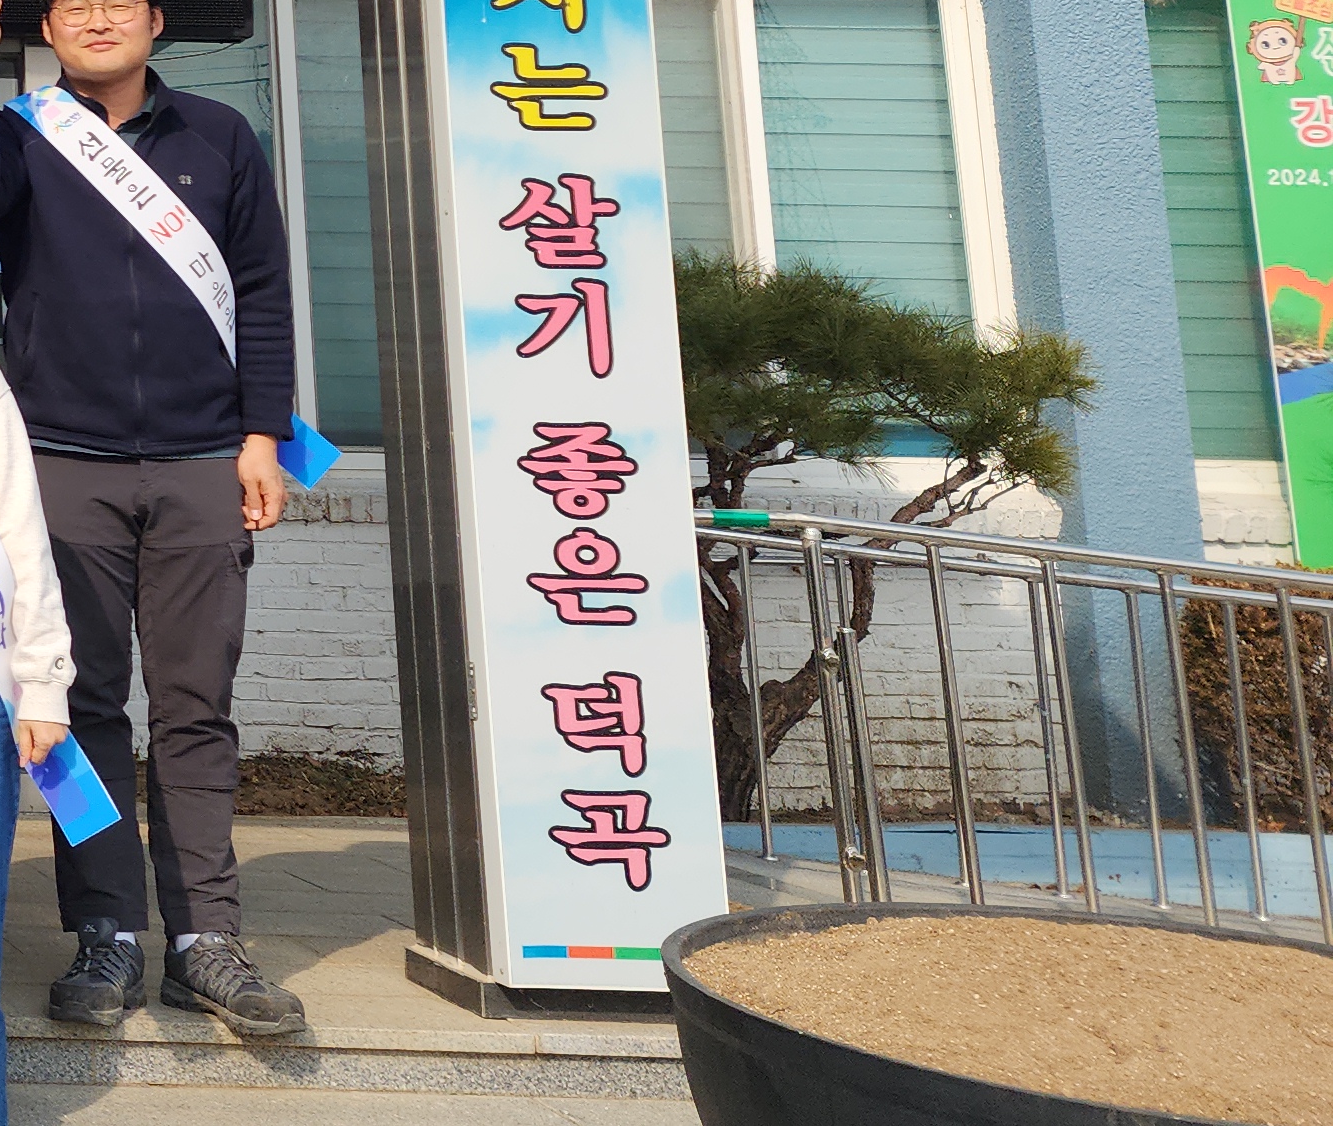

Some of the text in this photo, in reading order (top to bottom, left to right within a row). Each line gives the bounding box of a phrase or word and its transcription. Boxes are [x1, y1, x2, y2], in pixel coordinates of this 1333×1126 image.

[78, 130, 157, 211] 선물은
[148, 204, 191, 245] NO!
[499, 173, 620, 378] 살기
[518, 422, 648, 625] 좋은
[542, 671, 671, 892] 덕곡
